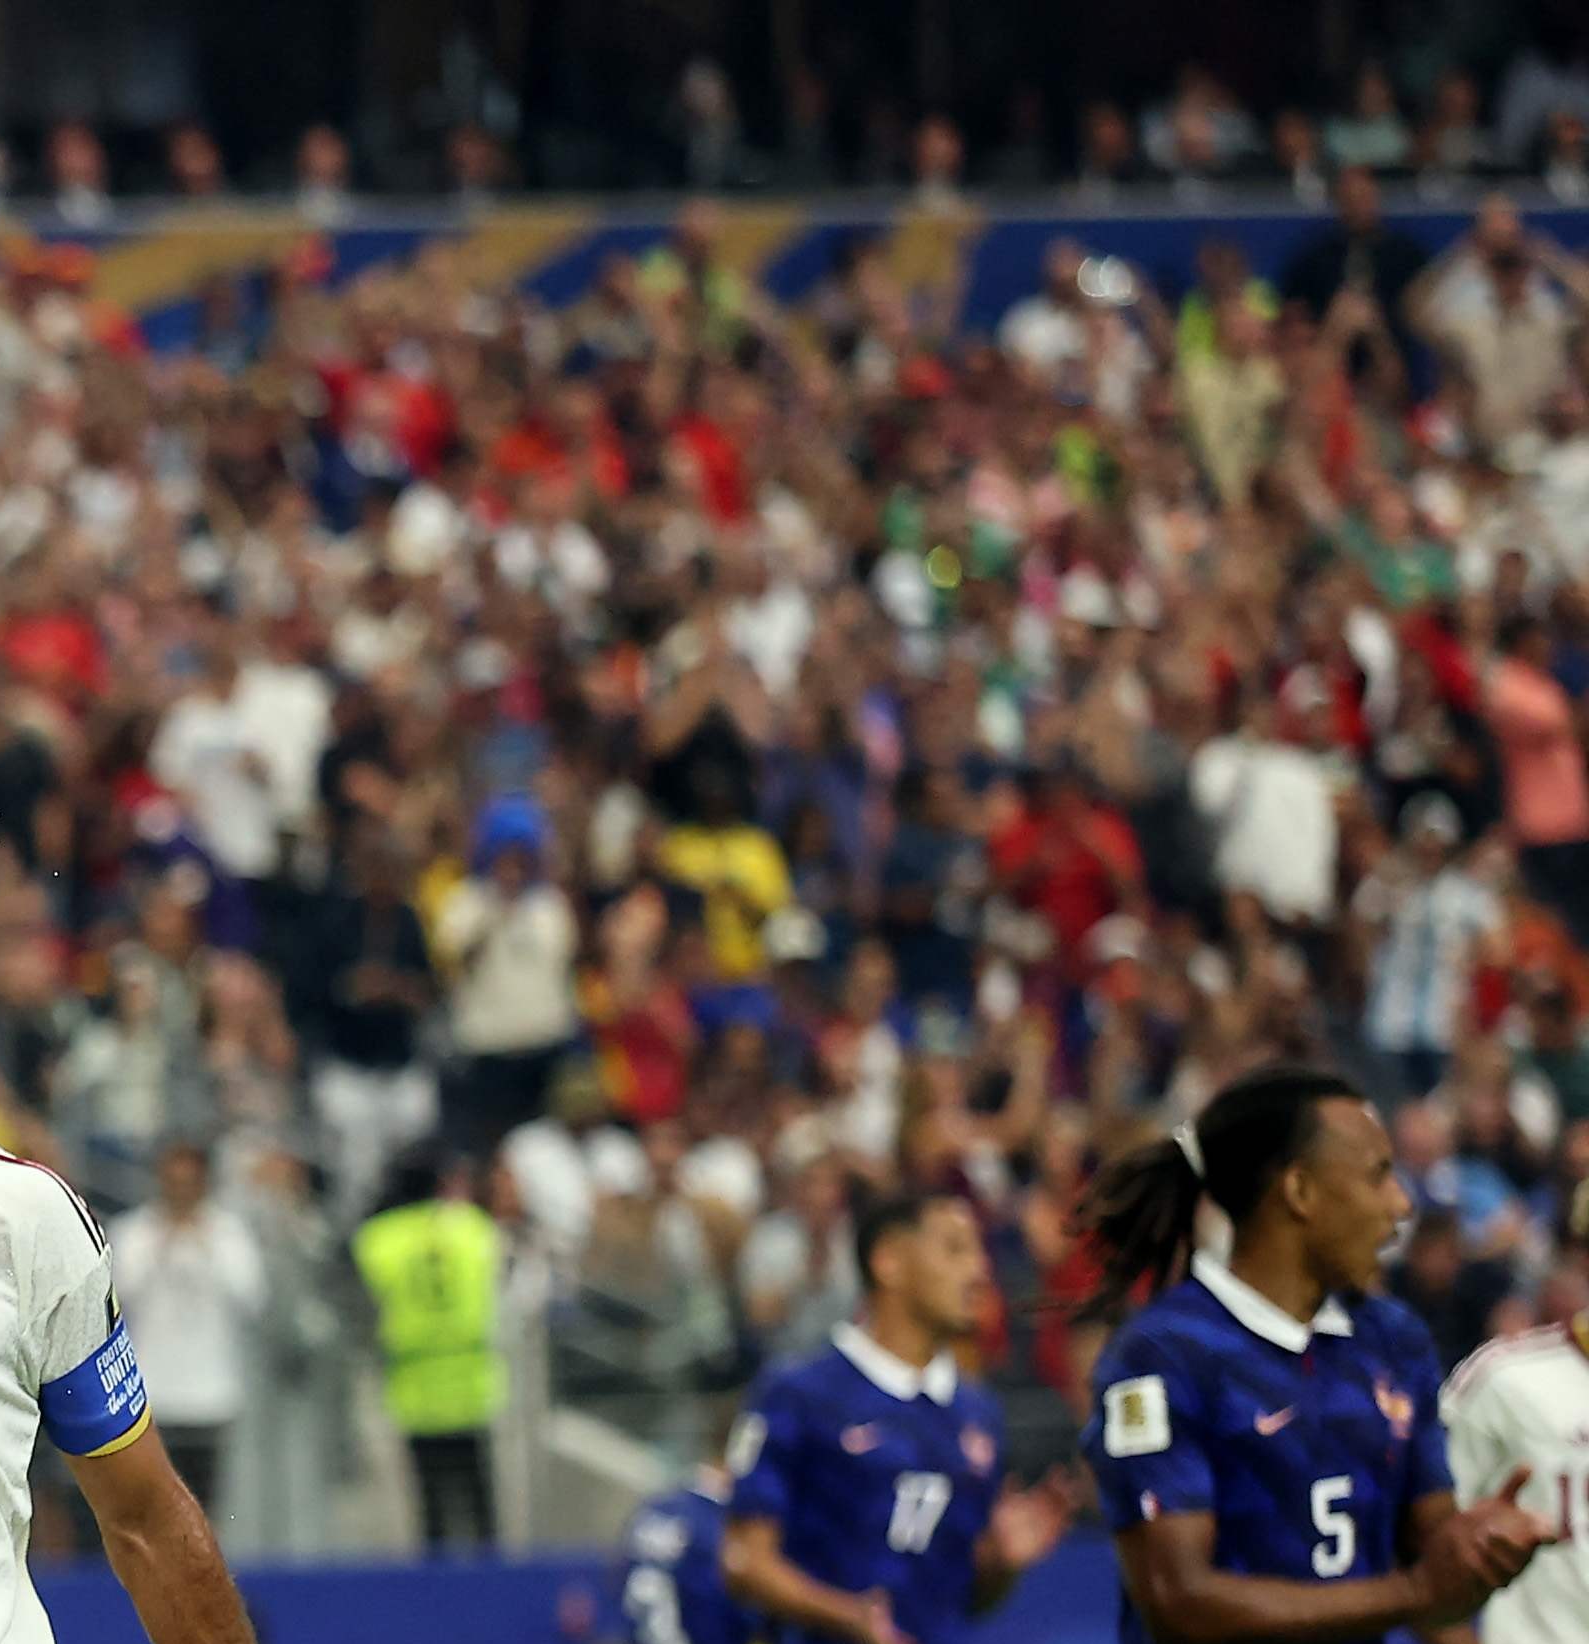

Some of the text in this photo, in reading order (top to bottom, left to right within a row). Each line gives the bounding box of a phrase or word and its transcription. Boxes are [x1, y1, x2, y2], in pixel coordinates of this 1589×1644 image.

[101, 1343, 137, 1394] UNITE
[885, 1471, 952, 1553] 17
[1310, 1474, 1355, 1579] 5
